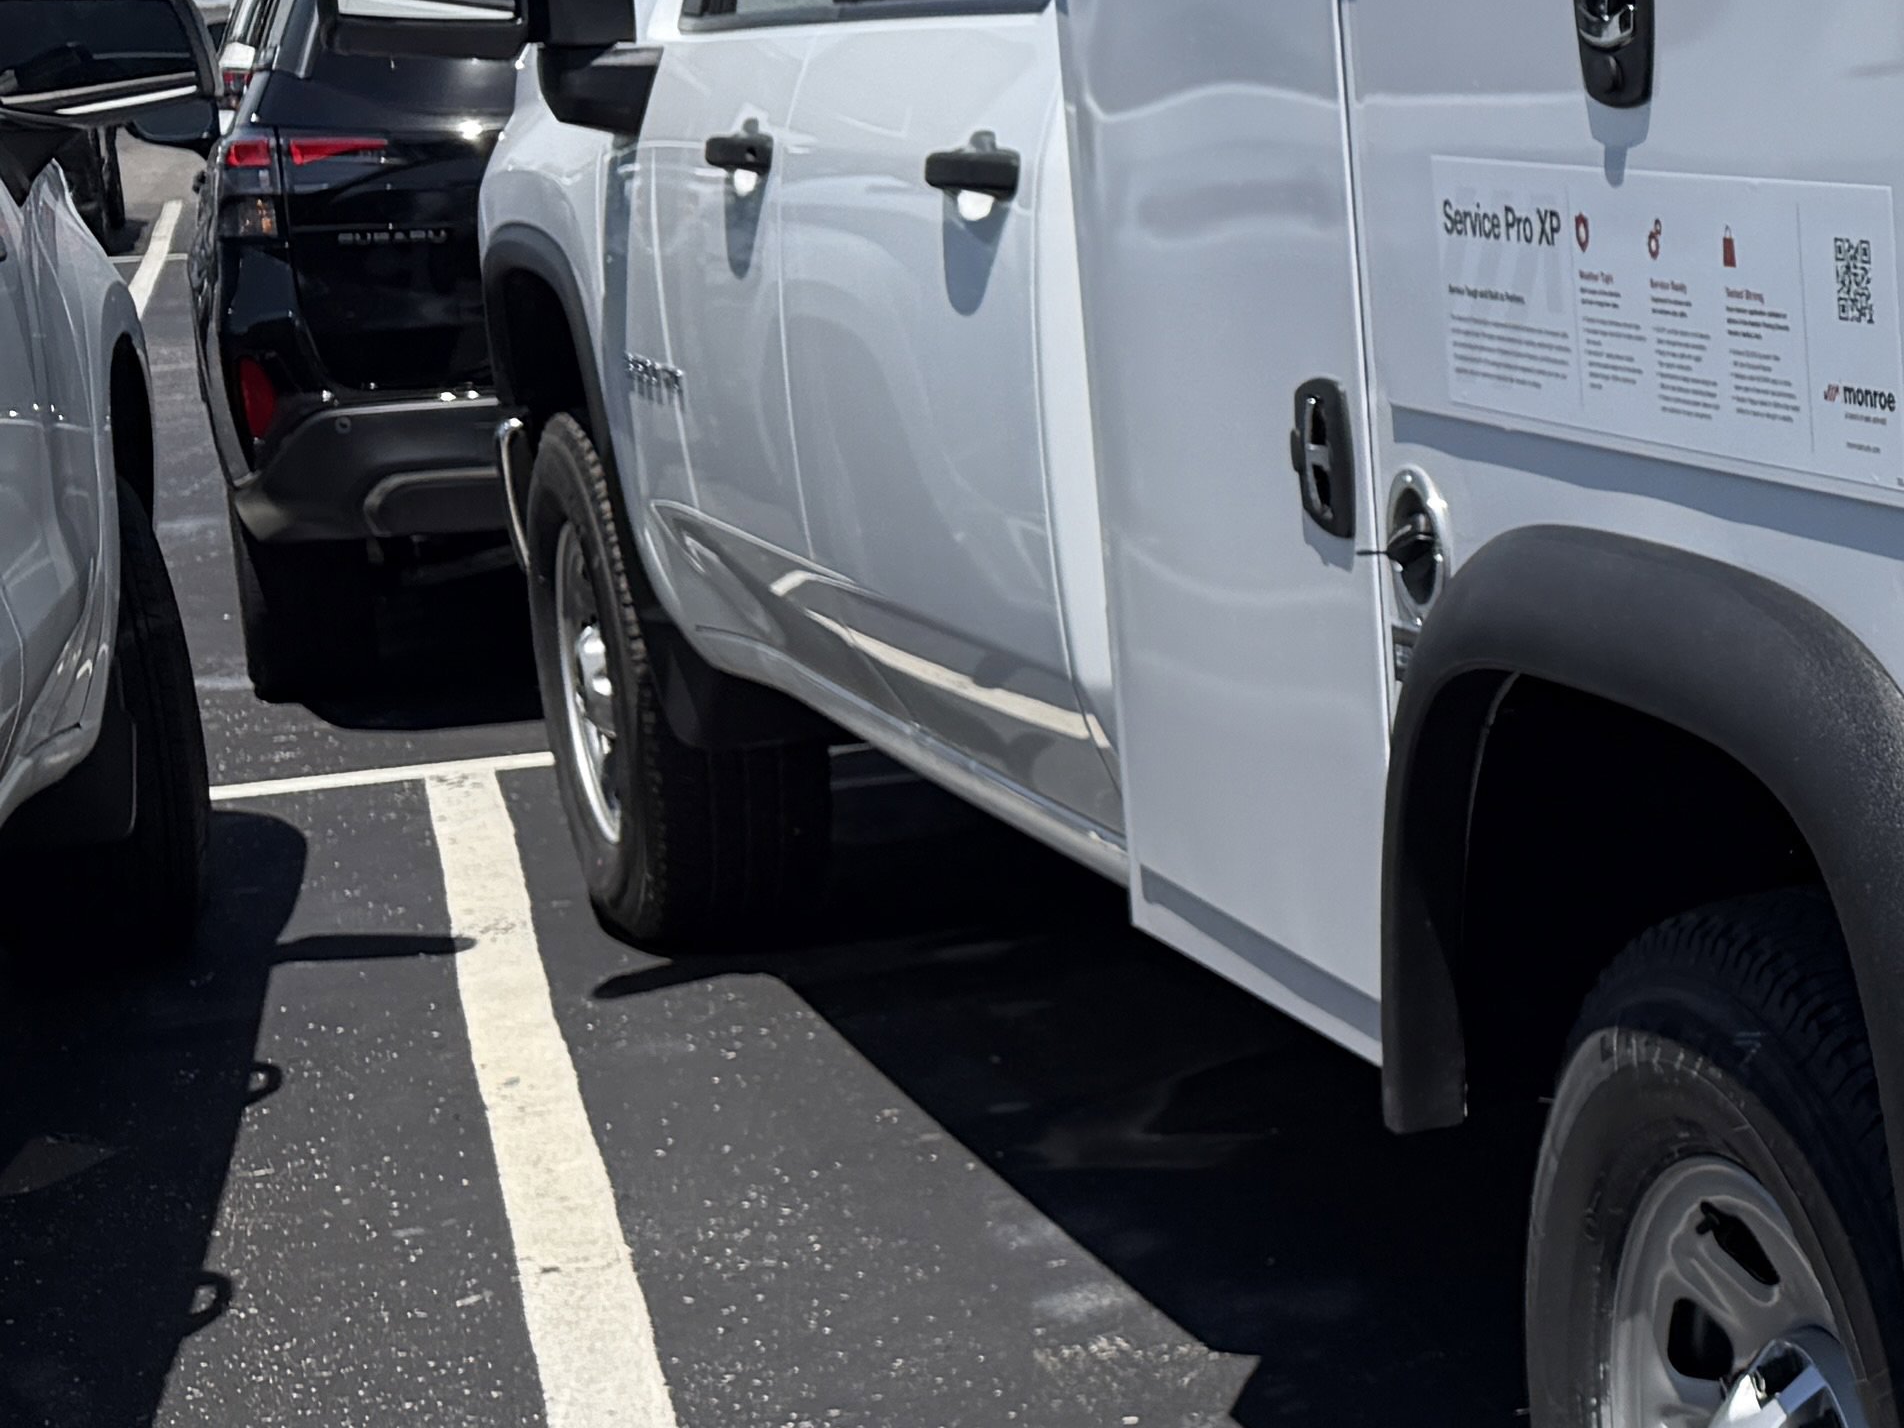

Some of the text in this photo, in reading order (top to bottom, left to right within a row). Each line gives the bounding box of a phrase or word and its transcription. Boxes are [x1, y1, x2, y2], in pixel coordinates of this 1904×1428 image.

[1442, 198, 1561, 246] Service Pro XP
[1843, 385, 1896, 412] monroe
